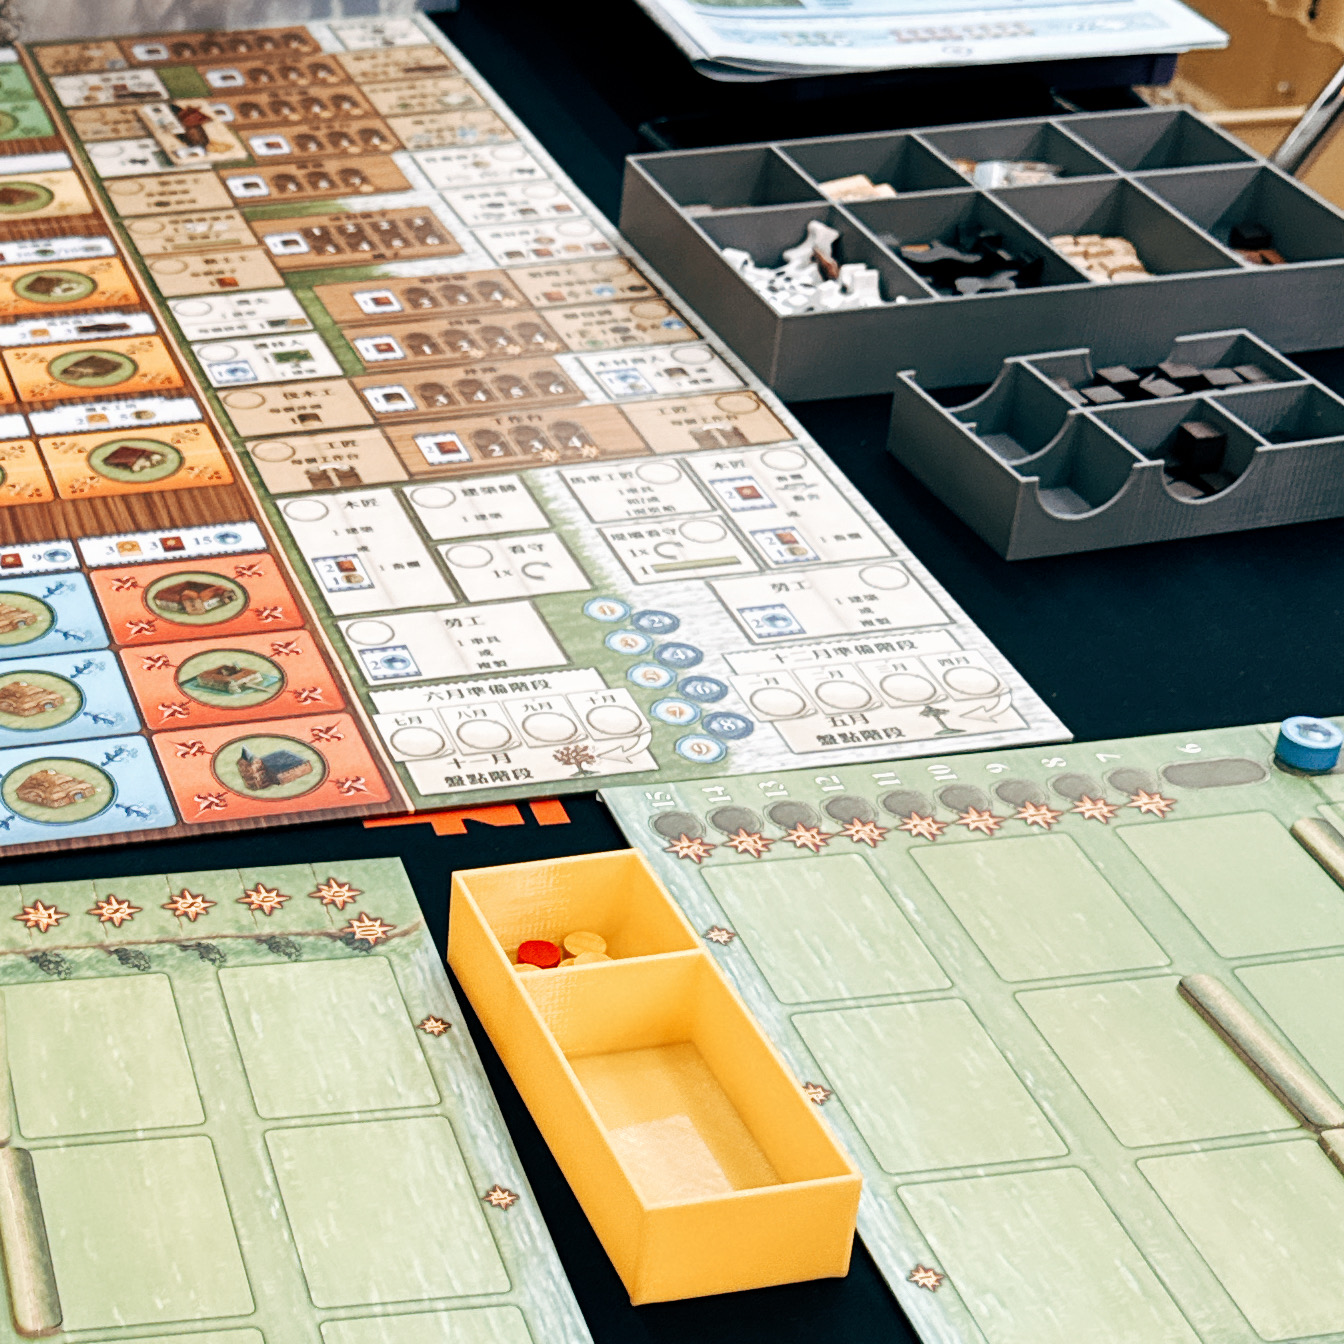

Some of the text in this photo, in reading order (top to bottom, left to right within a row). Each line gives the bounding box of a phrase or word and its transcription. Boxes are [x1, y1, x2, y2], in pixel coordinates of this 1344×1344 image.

[194, 535, 213, 547] 15
[774, 639, 919, 665] 十二月準備階段
[877, 661, 908, 673] 三月
[937, 655, 971, 667] 四月
[815, 668, 845, 680] 二月
[748, 676, 781, 686] 一月
[426, 678, 553, 703] 六月準備階段
[523, 700, 555, 712] 九月
[585, 694, 618, 706] 十月
[457, 708, 489, 719] 八月
[393, 714, 424, 727] 七月
[827, 713, 871, 728] 五月
[816, 727, 907, 746] 盤點階段
[445, 752, 513, 770] 十一月
[444, 767, 534, 788] 盤點階段
[646, 790, 675, 809] 15
[701, 784, 732, 804] 14
[758, 779, 790, 799] 13
[815, 773, 845, 793] 12
[871, 769, 902, 788] 11
[927, 763, 958, 783] 10
[1040, 756, 1066, 770] 8
